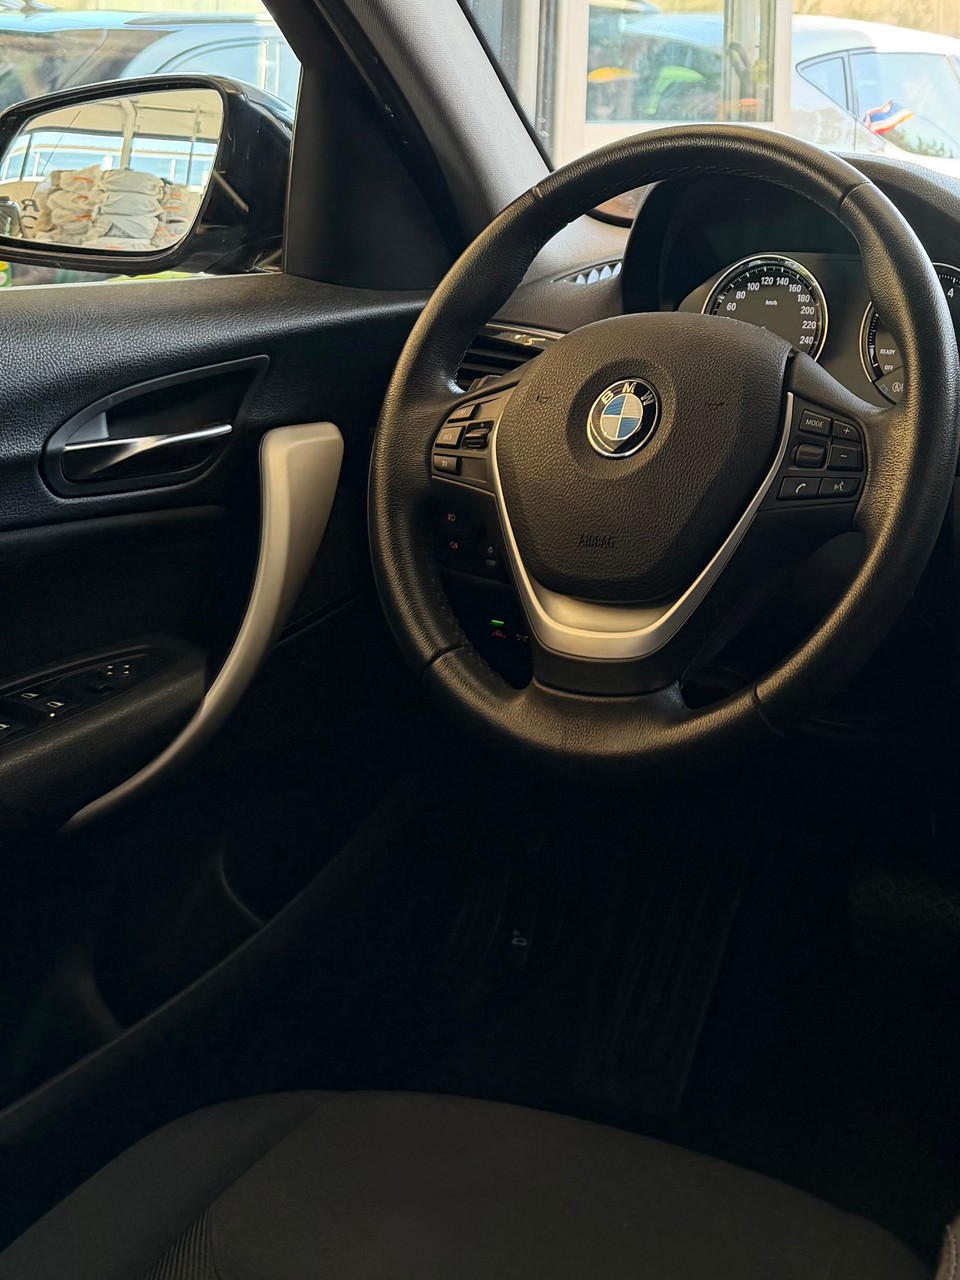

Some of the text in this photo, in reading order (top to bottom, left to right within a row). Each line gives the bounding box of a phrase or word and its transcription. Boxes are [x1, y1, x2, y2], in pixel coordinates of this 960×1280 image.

[761, 277, 774, 285] 120
[776, 277, 790, 286] 140
[747, 282, 760, 291] 100
[788, 284, 802, 293] 160
[735, 291, 746, 299] 80
[947, 288, 954, 298] 4
[797, 294, 811, 303] 180
[726, 302, 737, 311] 60
[800, 306, 815, 315] 200
[802, 320, 817, 329] 220
[799, 336, 815, 345] 240
[880, 348, 896, 356] READY
[601, 382, 655, 407] BMW
[805, 418, 825, 428] MODE
